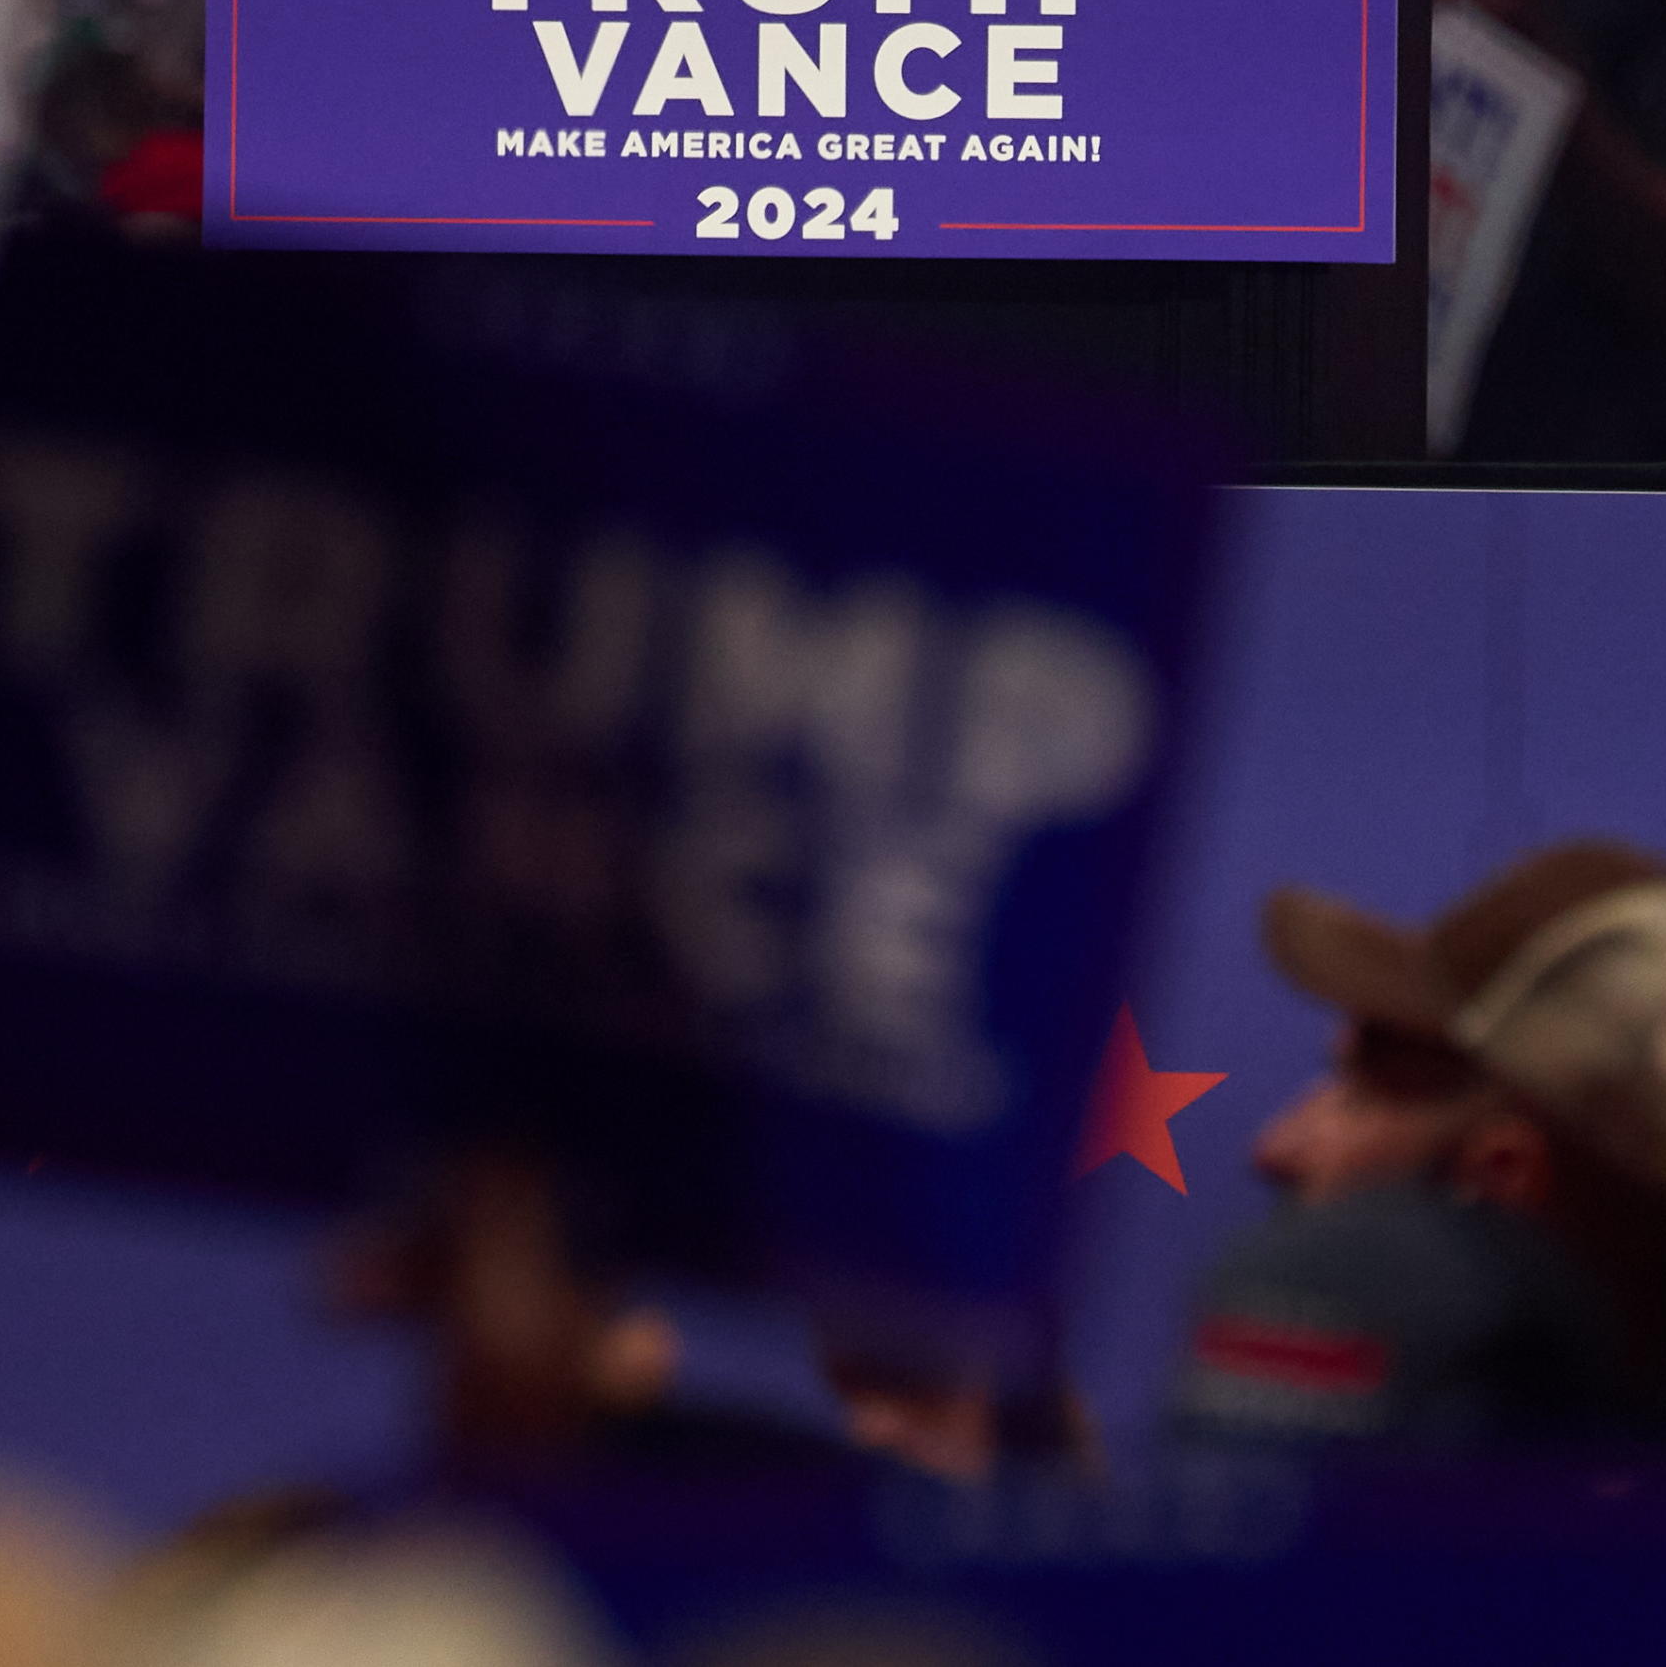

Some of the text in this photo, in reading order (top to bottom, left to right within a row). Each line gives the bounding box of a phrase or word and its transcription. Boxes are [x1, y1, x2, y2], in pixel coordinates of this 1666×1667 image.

[531, 20, 1064, 121] VANCE
[496, 128, 1102, 163] MAKE AMERICA GREAT AGAIN!
[695, 185, 901, 241] 2024
